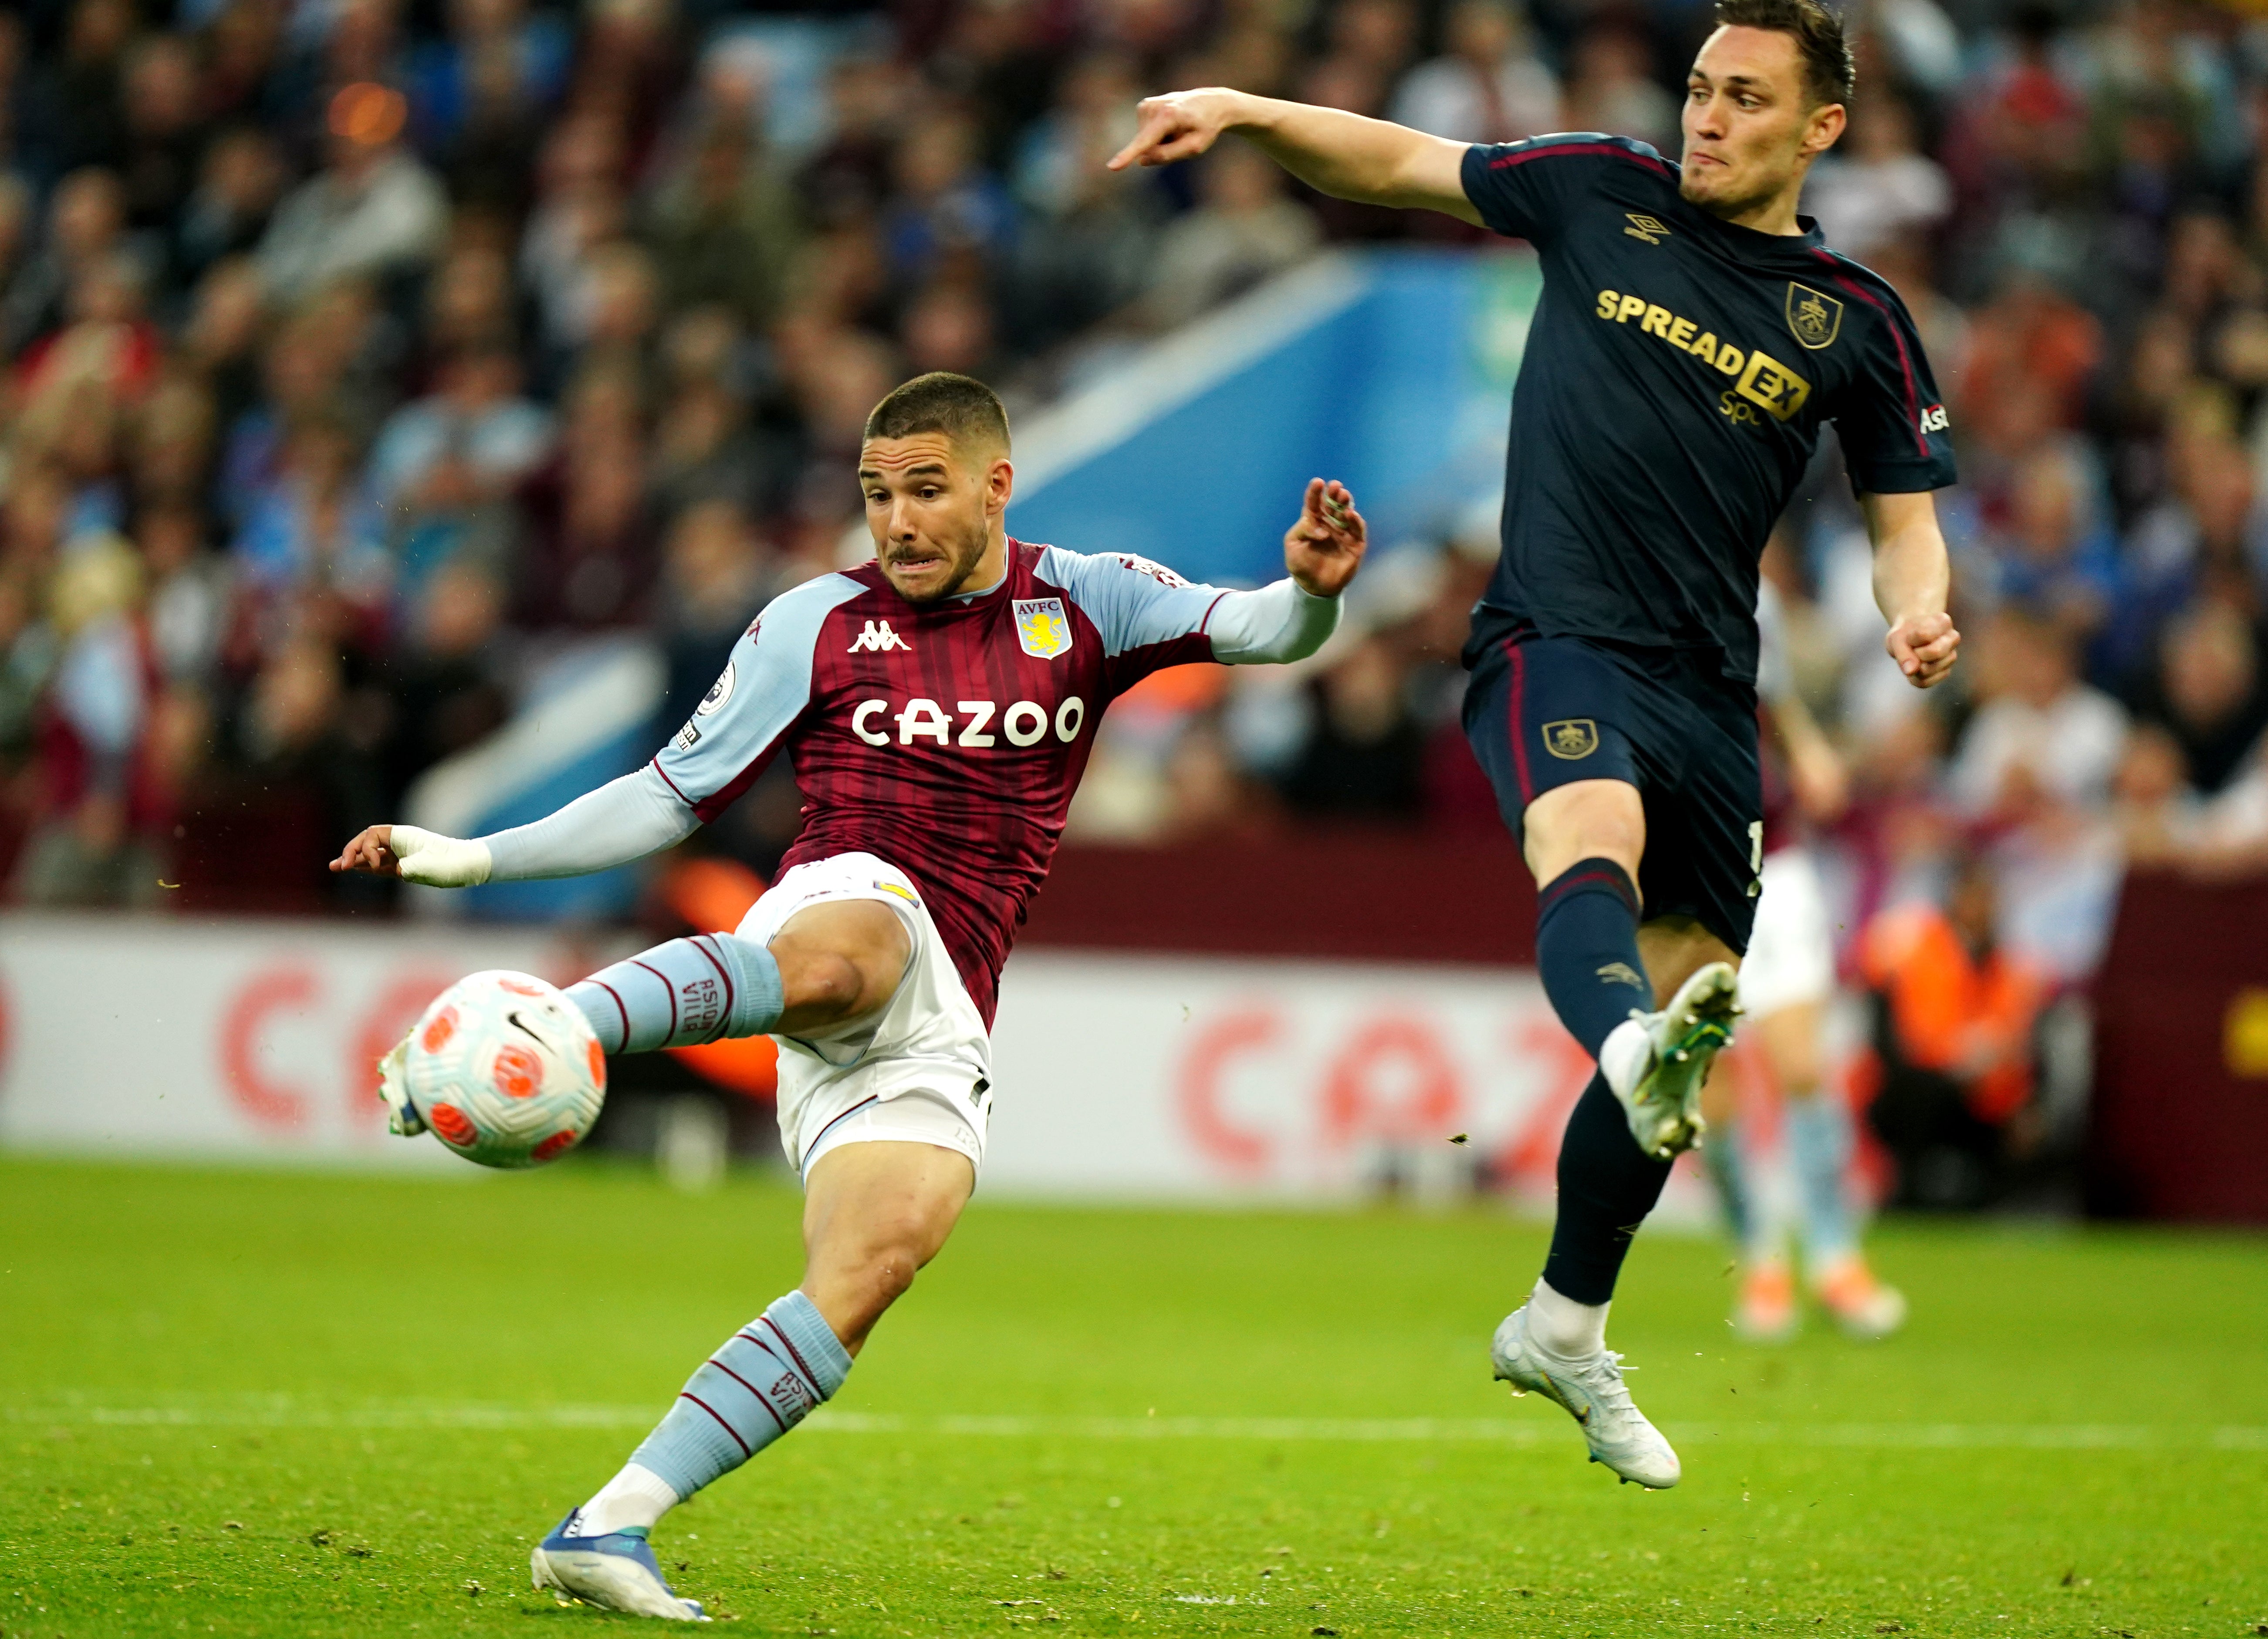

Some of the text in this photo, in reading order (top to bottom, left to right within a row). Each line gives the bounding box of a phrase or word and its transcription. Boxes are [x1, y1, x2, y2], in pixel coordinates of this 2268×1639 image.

[1596, 289, 1801, 412] SPREADEX
[1018, 601, 1059, 614] AVFC
[852, 696, 1085, 747] CAZOO
